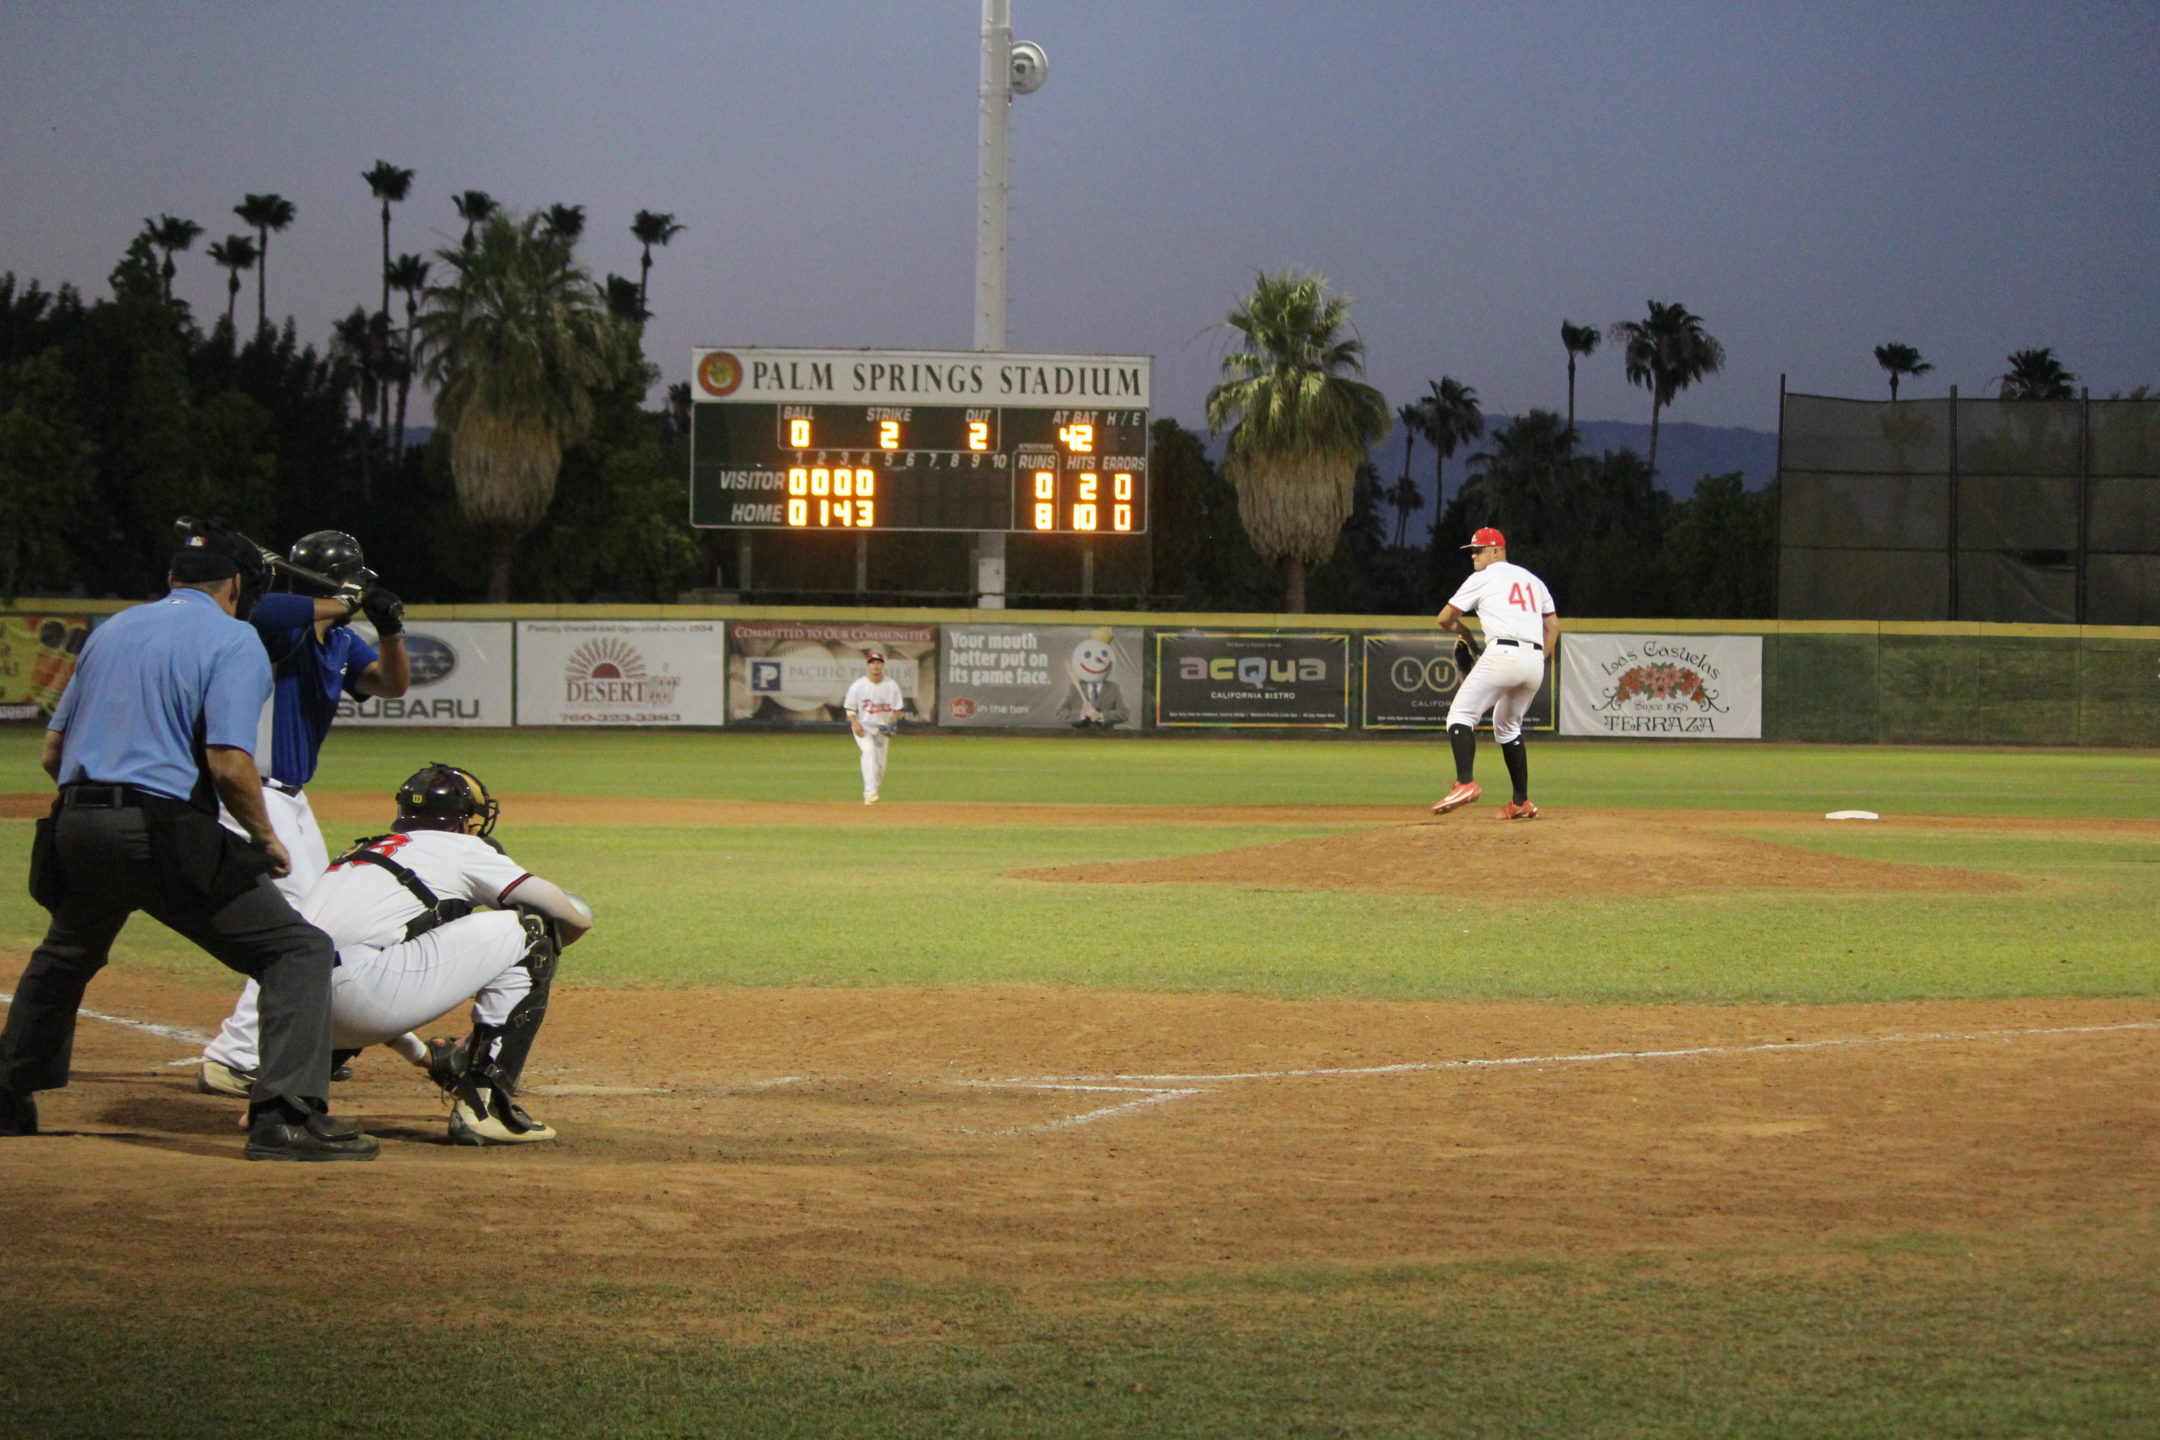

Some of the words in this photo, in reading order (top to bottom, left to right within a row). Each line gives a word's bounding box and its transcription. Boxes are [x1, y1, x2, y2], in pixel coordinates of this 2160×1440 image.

[752, 361, 835, 392] PALM
[853, 363, 983, 394] SPRINGS
[1000, 365, 1141, 396] STADIUM
[783, 406, 815, 420] BALL
[866, 407, 912, 422] STRIKE
[965, 409, 992, 423] OUT
[1052, 411, 1069, 424] AT
[1073, 411, 1098, 425] BAT
[1107, 412, 1117, 426] H
[1132, 412, 1141, 426] E
[790, 419, 810, 448] 0
[880, 420, 899, 449] 2
[968, 422, 988, 450] 2
[1059, 424, 1093, 452] 42
[795, 452, 803, 465] 1
[817, 452, 827, 465] 2
[840, 452, 849, 465] 3
[862, 452, 871, 465] 4
[884, 453, 893, 466] 5
[906, 453, 915, 467] 6
[929, 453, 937, 467] 7
[950, 454, 959, 467] 8
[970, 454, 980, 468] 9
[992, 454, 1007, 469] 10
[1018, 455, 1055, 469] RUNS
[1067, 456, 1096, 470] HITS
[1102, 456, 1146, 471] ERRORS
[720, 471, 786, 490] VISITOR
[789, 468, 807, 496] 0
[811, 468, 830, 497] 0
[833, 468, 852, 497] 0
[855, 469, 874, 497] 0
[1035, 472, 1053, 500] 0
[1079, 472, 1098, 501] 2
[1114, 473, 1132, 501] 0
[731, 503, 783, 523] HOME
[788, 498, 807, 527] 0
[833, 499, 852, 527] 4
[855, 500, 874, 528] 3
[1035, 502, 1053, 531] 8
[1073, 503, 1097, 532] 10
[1114, 503, 1132, 532] 0
[1508, 582, 1537, 613] 41
[734, 628, 804, 640] COMMITTED
[808, 629, 821, 639] TO
[824, 628, 849, 640] OUR
[851, 628, 931, 641] COMMUNITIES
[949, 631, 985, 649] Your
[988, 632, 1038, 649] mouth
[949, 649, 997, 667] better
[1000, 650, 1026, 669] put
[1029, 653, 1049, 667] on
[1600, 650, 1638, 677] Las
[1643, 640, 1721, 681] Casuelas
[757, 664, 779, 689] P
[789, 666, 844, 678] PACIFIC
[949, 666, 969, 683] its
[971, 669, 1014, 686] game
[1016, 667, 1052, 685] face.
[566, 680, 648, 702] DESERT
[1210, 691, 1262, 700] CALIFORNIA
[1264, 692, 1296, 700] BISTRO
[334, 698, 480, 719] SUBARU
[1411, 699, 1451, 708] CALIFOR
[1633, 701, 1664, 713] Since
[1604, 715, 1716, 733] TERRAZA
